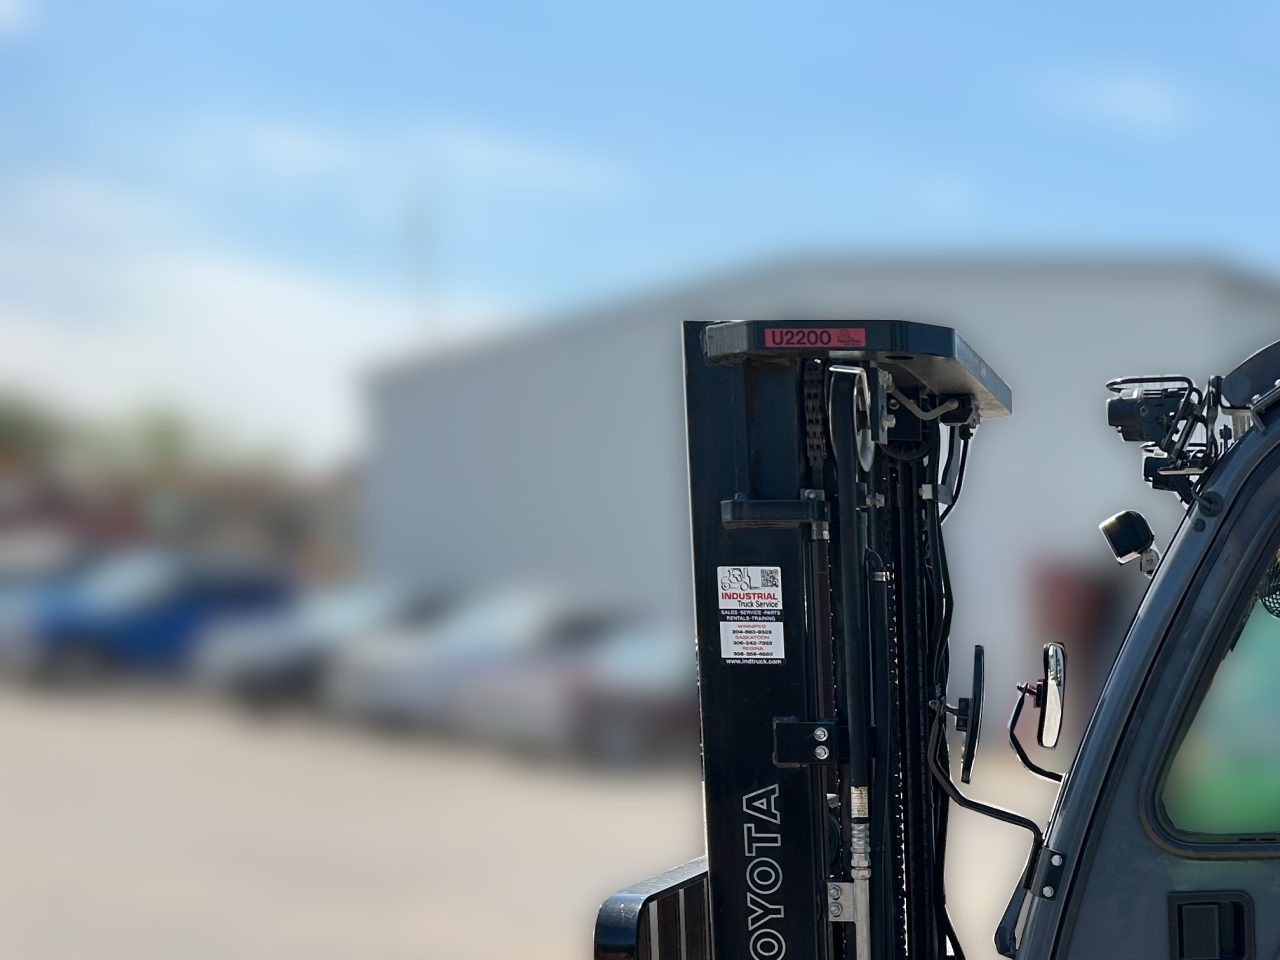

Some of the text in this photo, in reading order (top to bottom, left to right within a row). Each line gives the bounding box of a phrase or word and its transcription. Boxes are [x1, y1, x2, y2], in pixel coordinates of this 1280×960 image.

[771, 330, 832, 346] U2200
[721, 592, 778, 600] INDUSTRIAL
[737, 600, 755, 608] Truck
